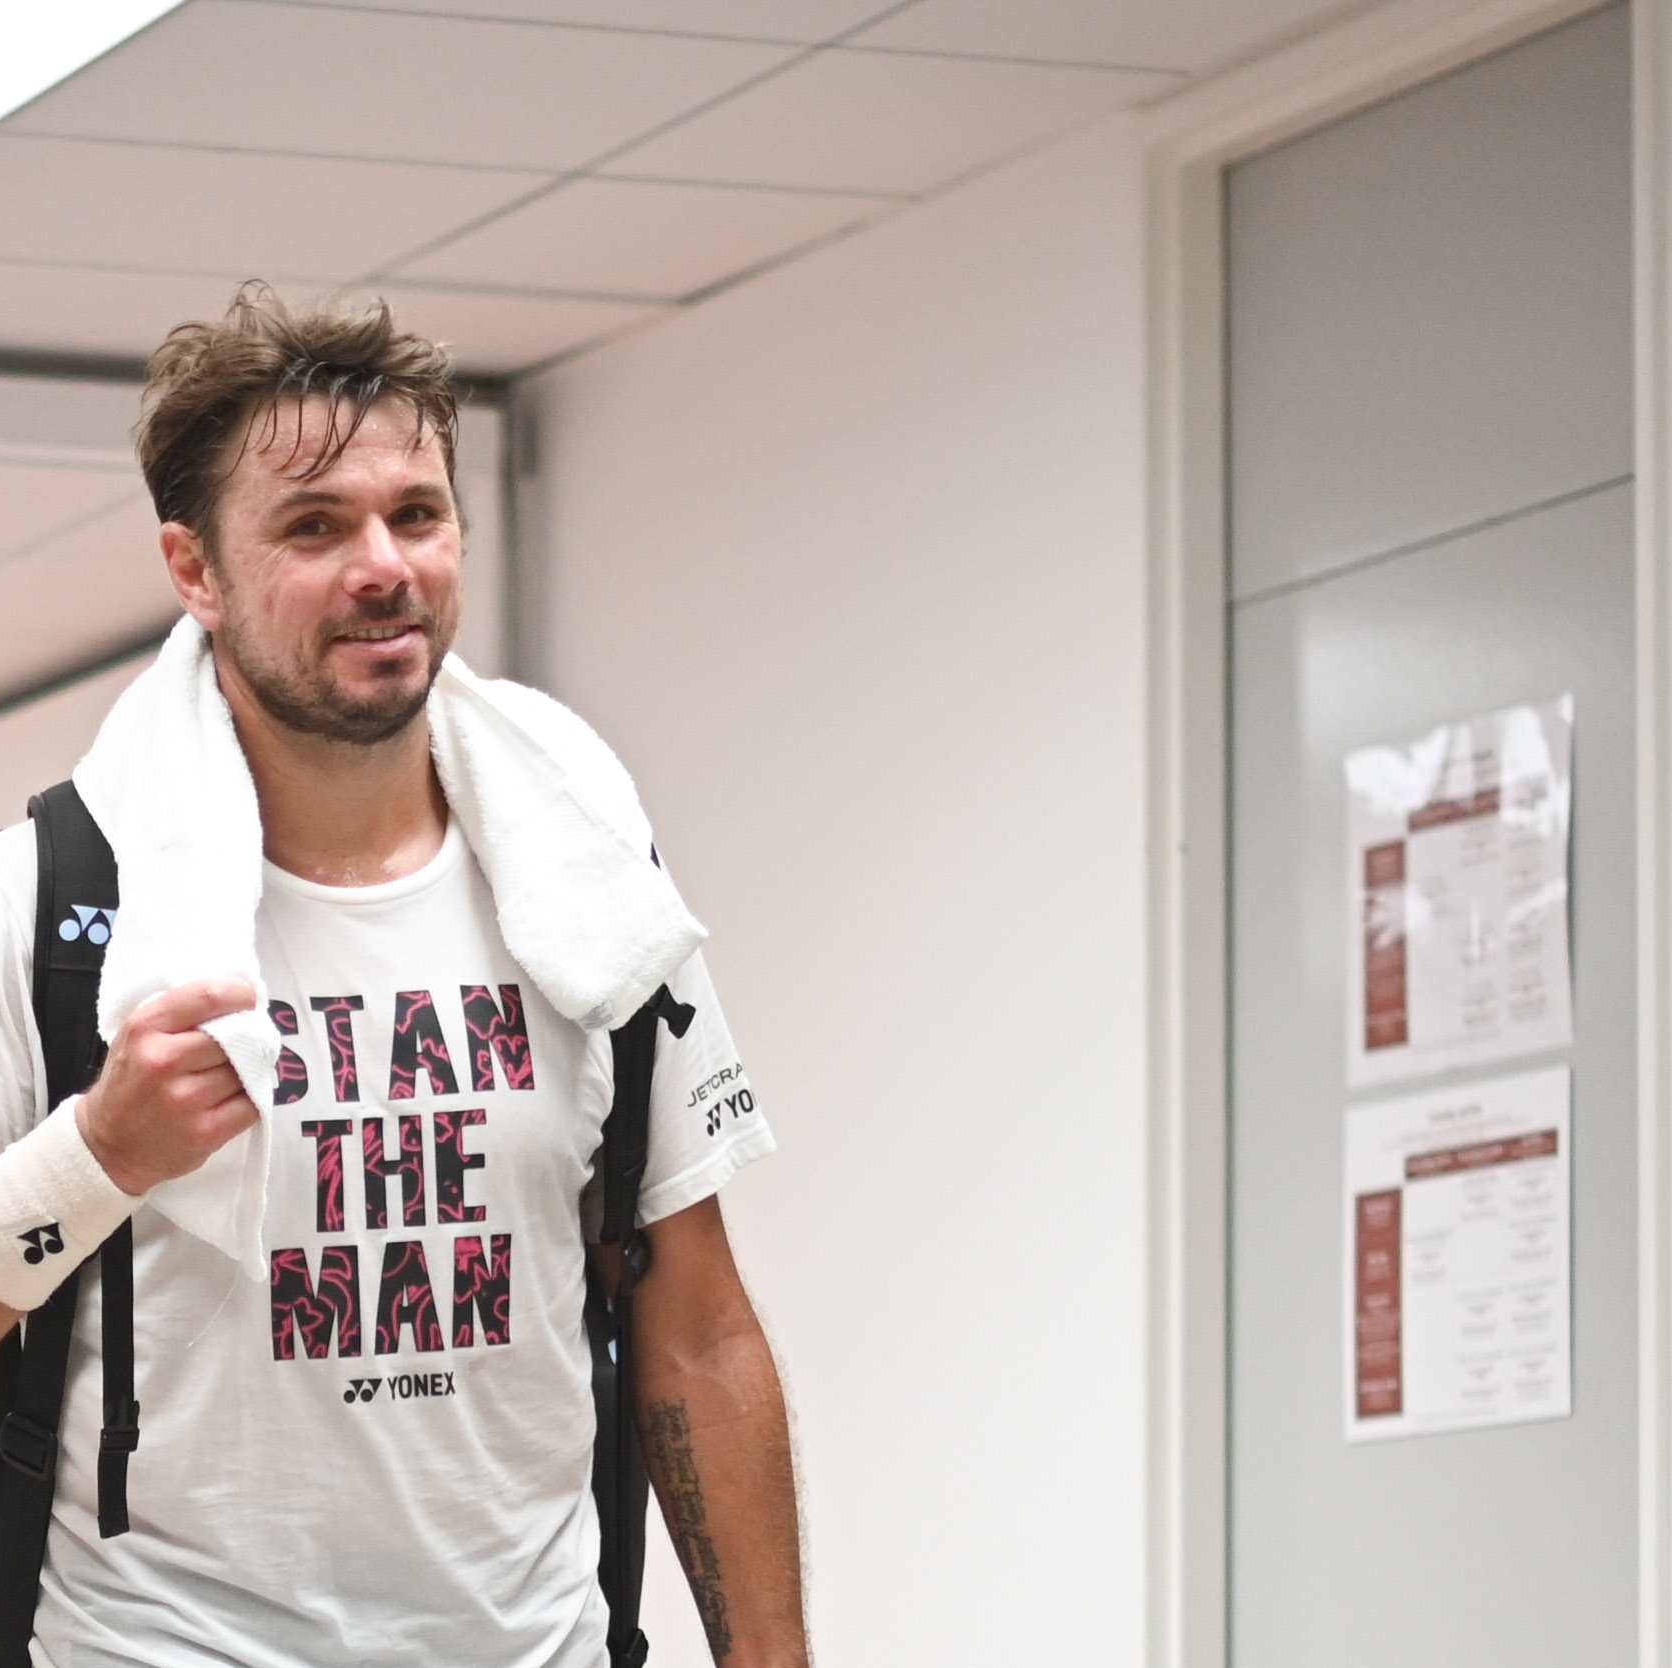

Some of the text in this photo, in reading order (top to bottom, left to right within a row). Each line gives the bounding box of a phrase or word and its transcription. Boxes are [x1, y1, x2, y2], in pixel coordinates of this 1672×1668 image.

[267, 983, 535, 1106] STAN
[687, 1062, 744, 1108] JETCRA
[724, 1088, 757, 1119] YO
[301, 1109, 487, 1232] THE
[271, 1233, 512, 1361] MAN
[387, 1371, 455, 1400] YONEX
